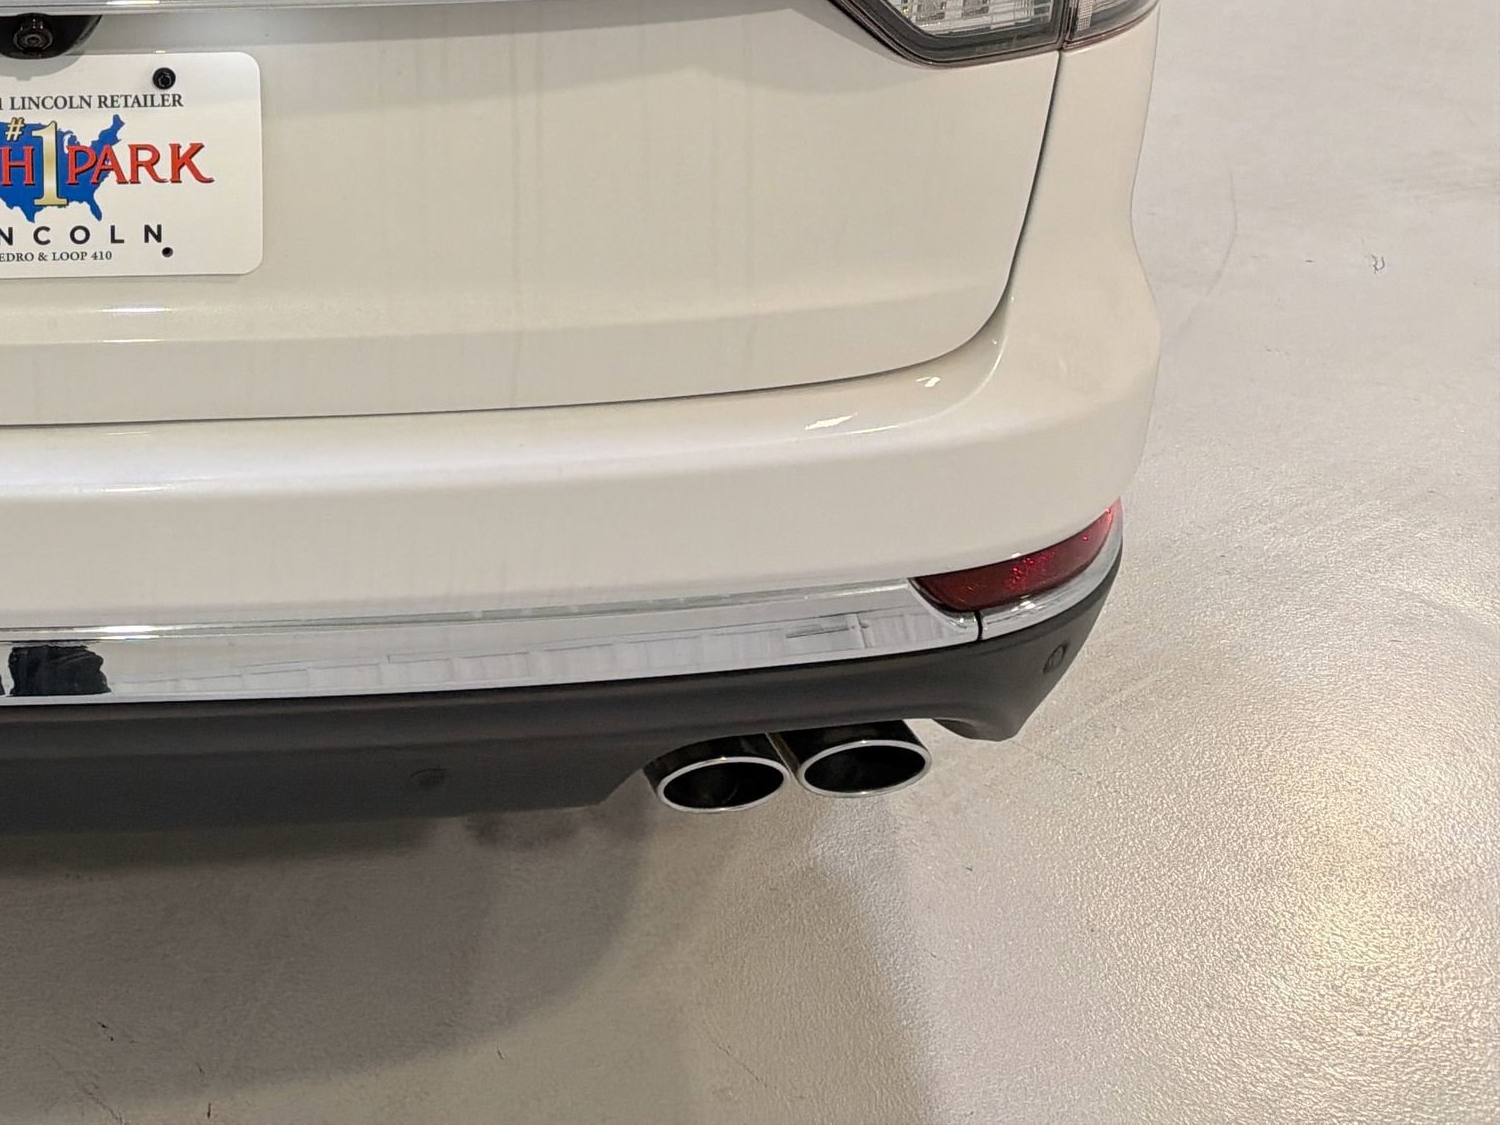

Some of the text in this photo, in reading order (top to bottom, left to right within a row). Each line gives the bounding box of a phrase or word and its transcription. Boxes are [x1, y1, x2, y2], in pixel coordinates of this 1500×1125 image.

[9, 94, 93, 111] LINCOLN
[98, 93, 184, 109] RETAILER
[65, 142, 215, 186] PARK
[38, 252, 49, 262] &
[52, 251, 88, 262] LOOP
[91, 250, 113, 261] 410
